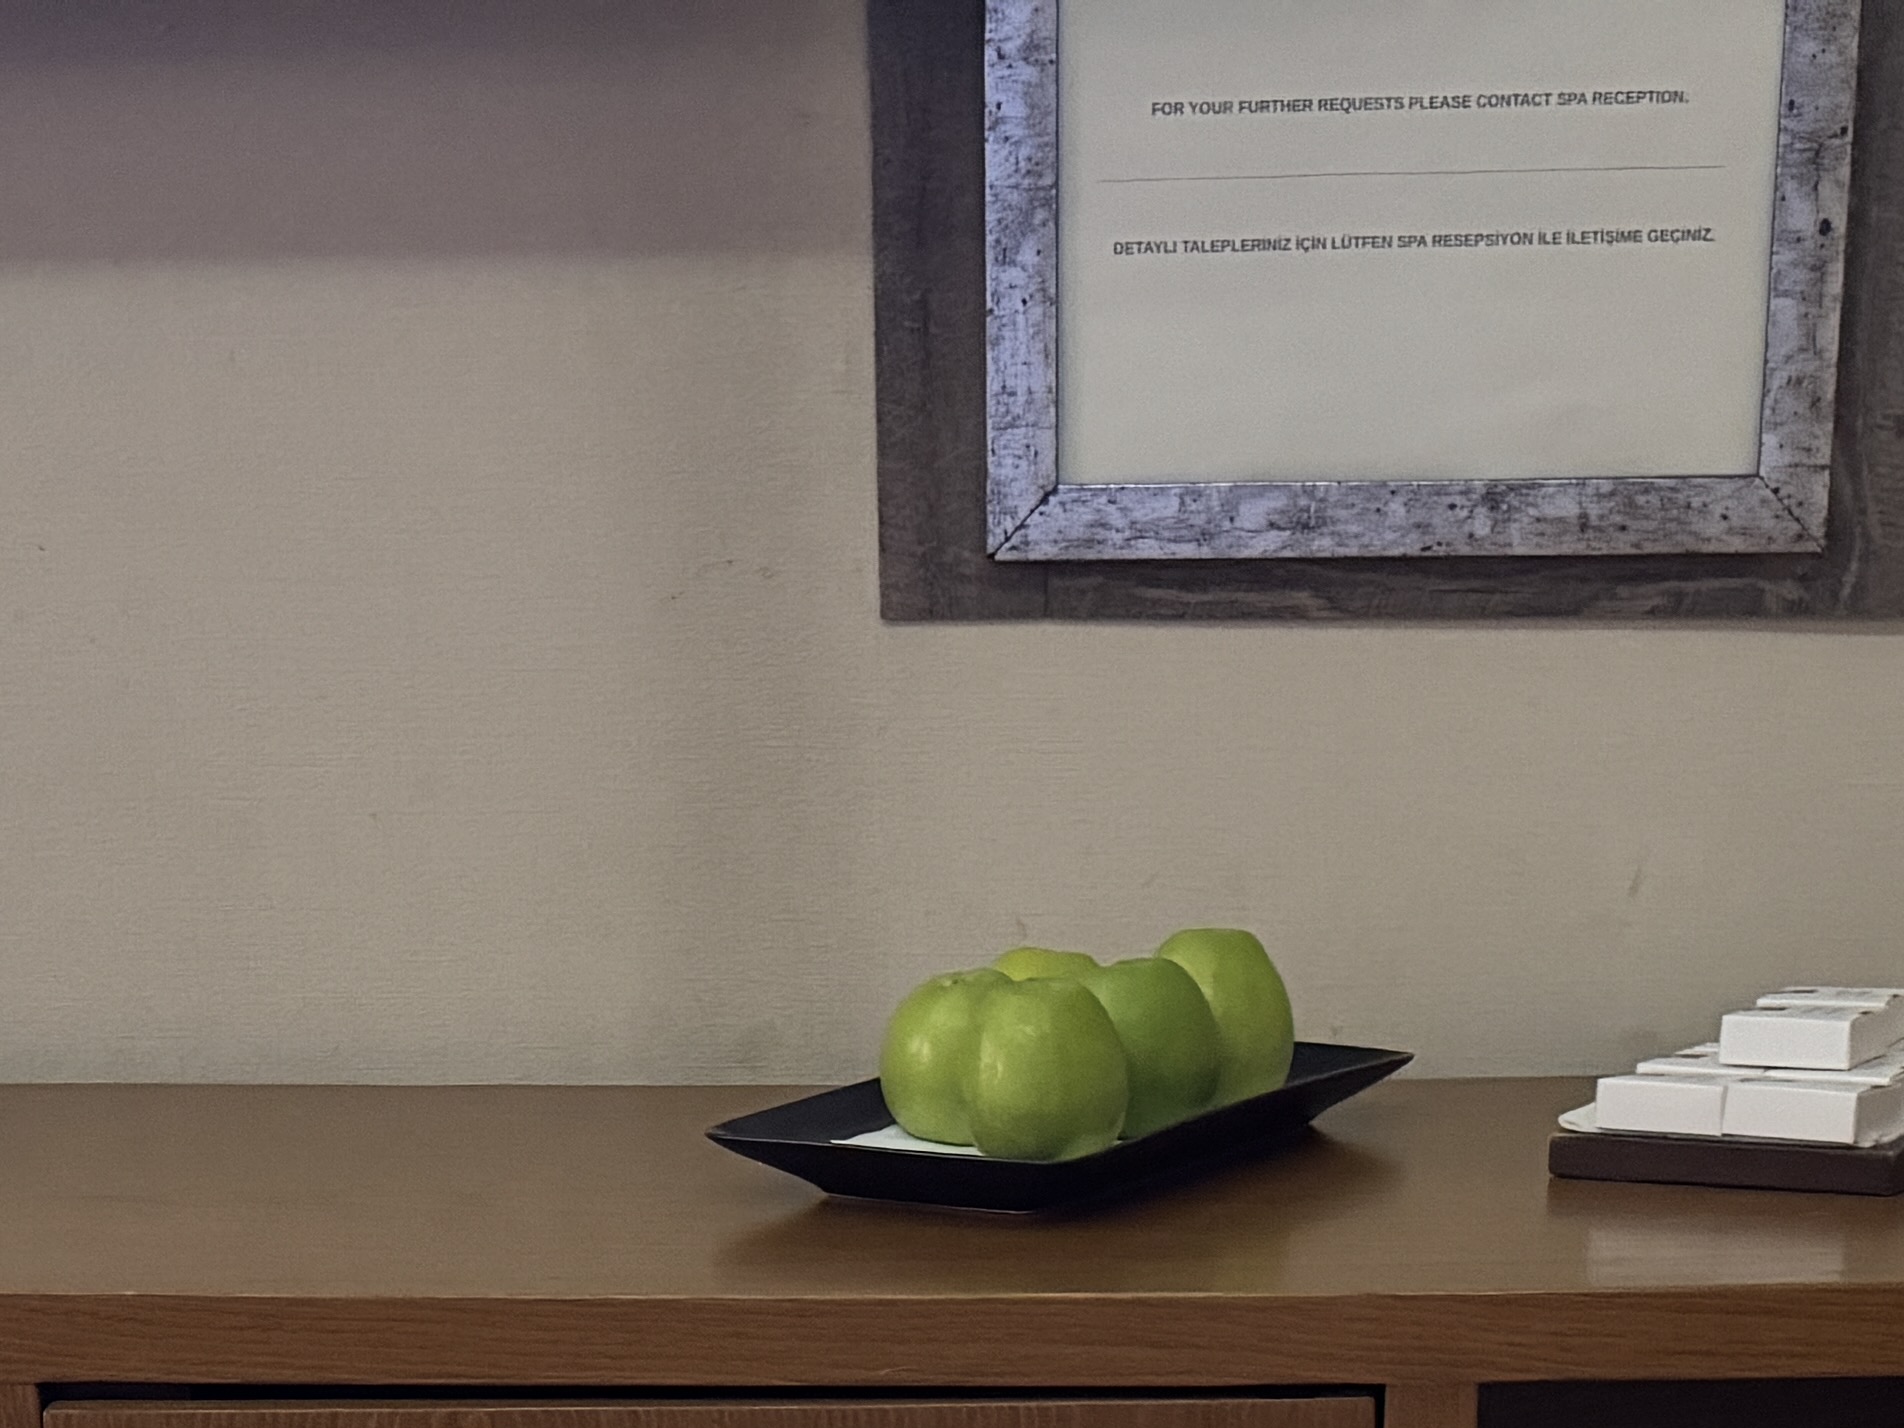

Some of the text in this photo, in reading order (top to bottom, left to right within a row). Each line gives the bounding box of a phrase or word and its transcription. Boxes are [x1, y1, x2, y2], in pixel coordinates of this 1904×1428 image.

[1151, 90, 1690, 116] FOR YOUR FURTHER REQUESTS PLEASE CONTACT SPA RECEPTION.
[1113, 240, 1177, 255] DETAYLI
[1331, 233, 1393, 250] LÜTFEN
[1397, 234, 1428, 248] SPA
[1431, 230, 1534, 247] RESEPSİYON
